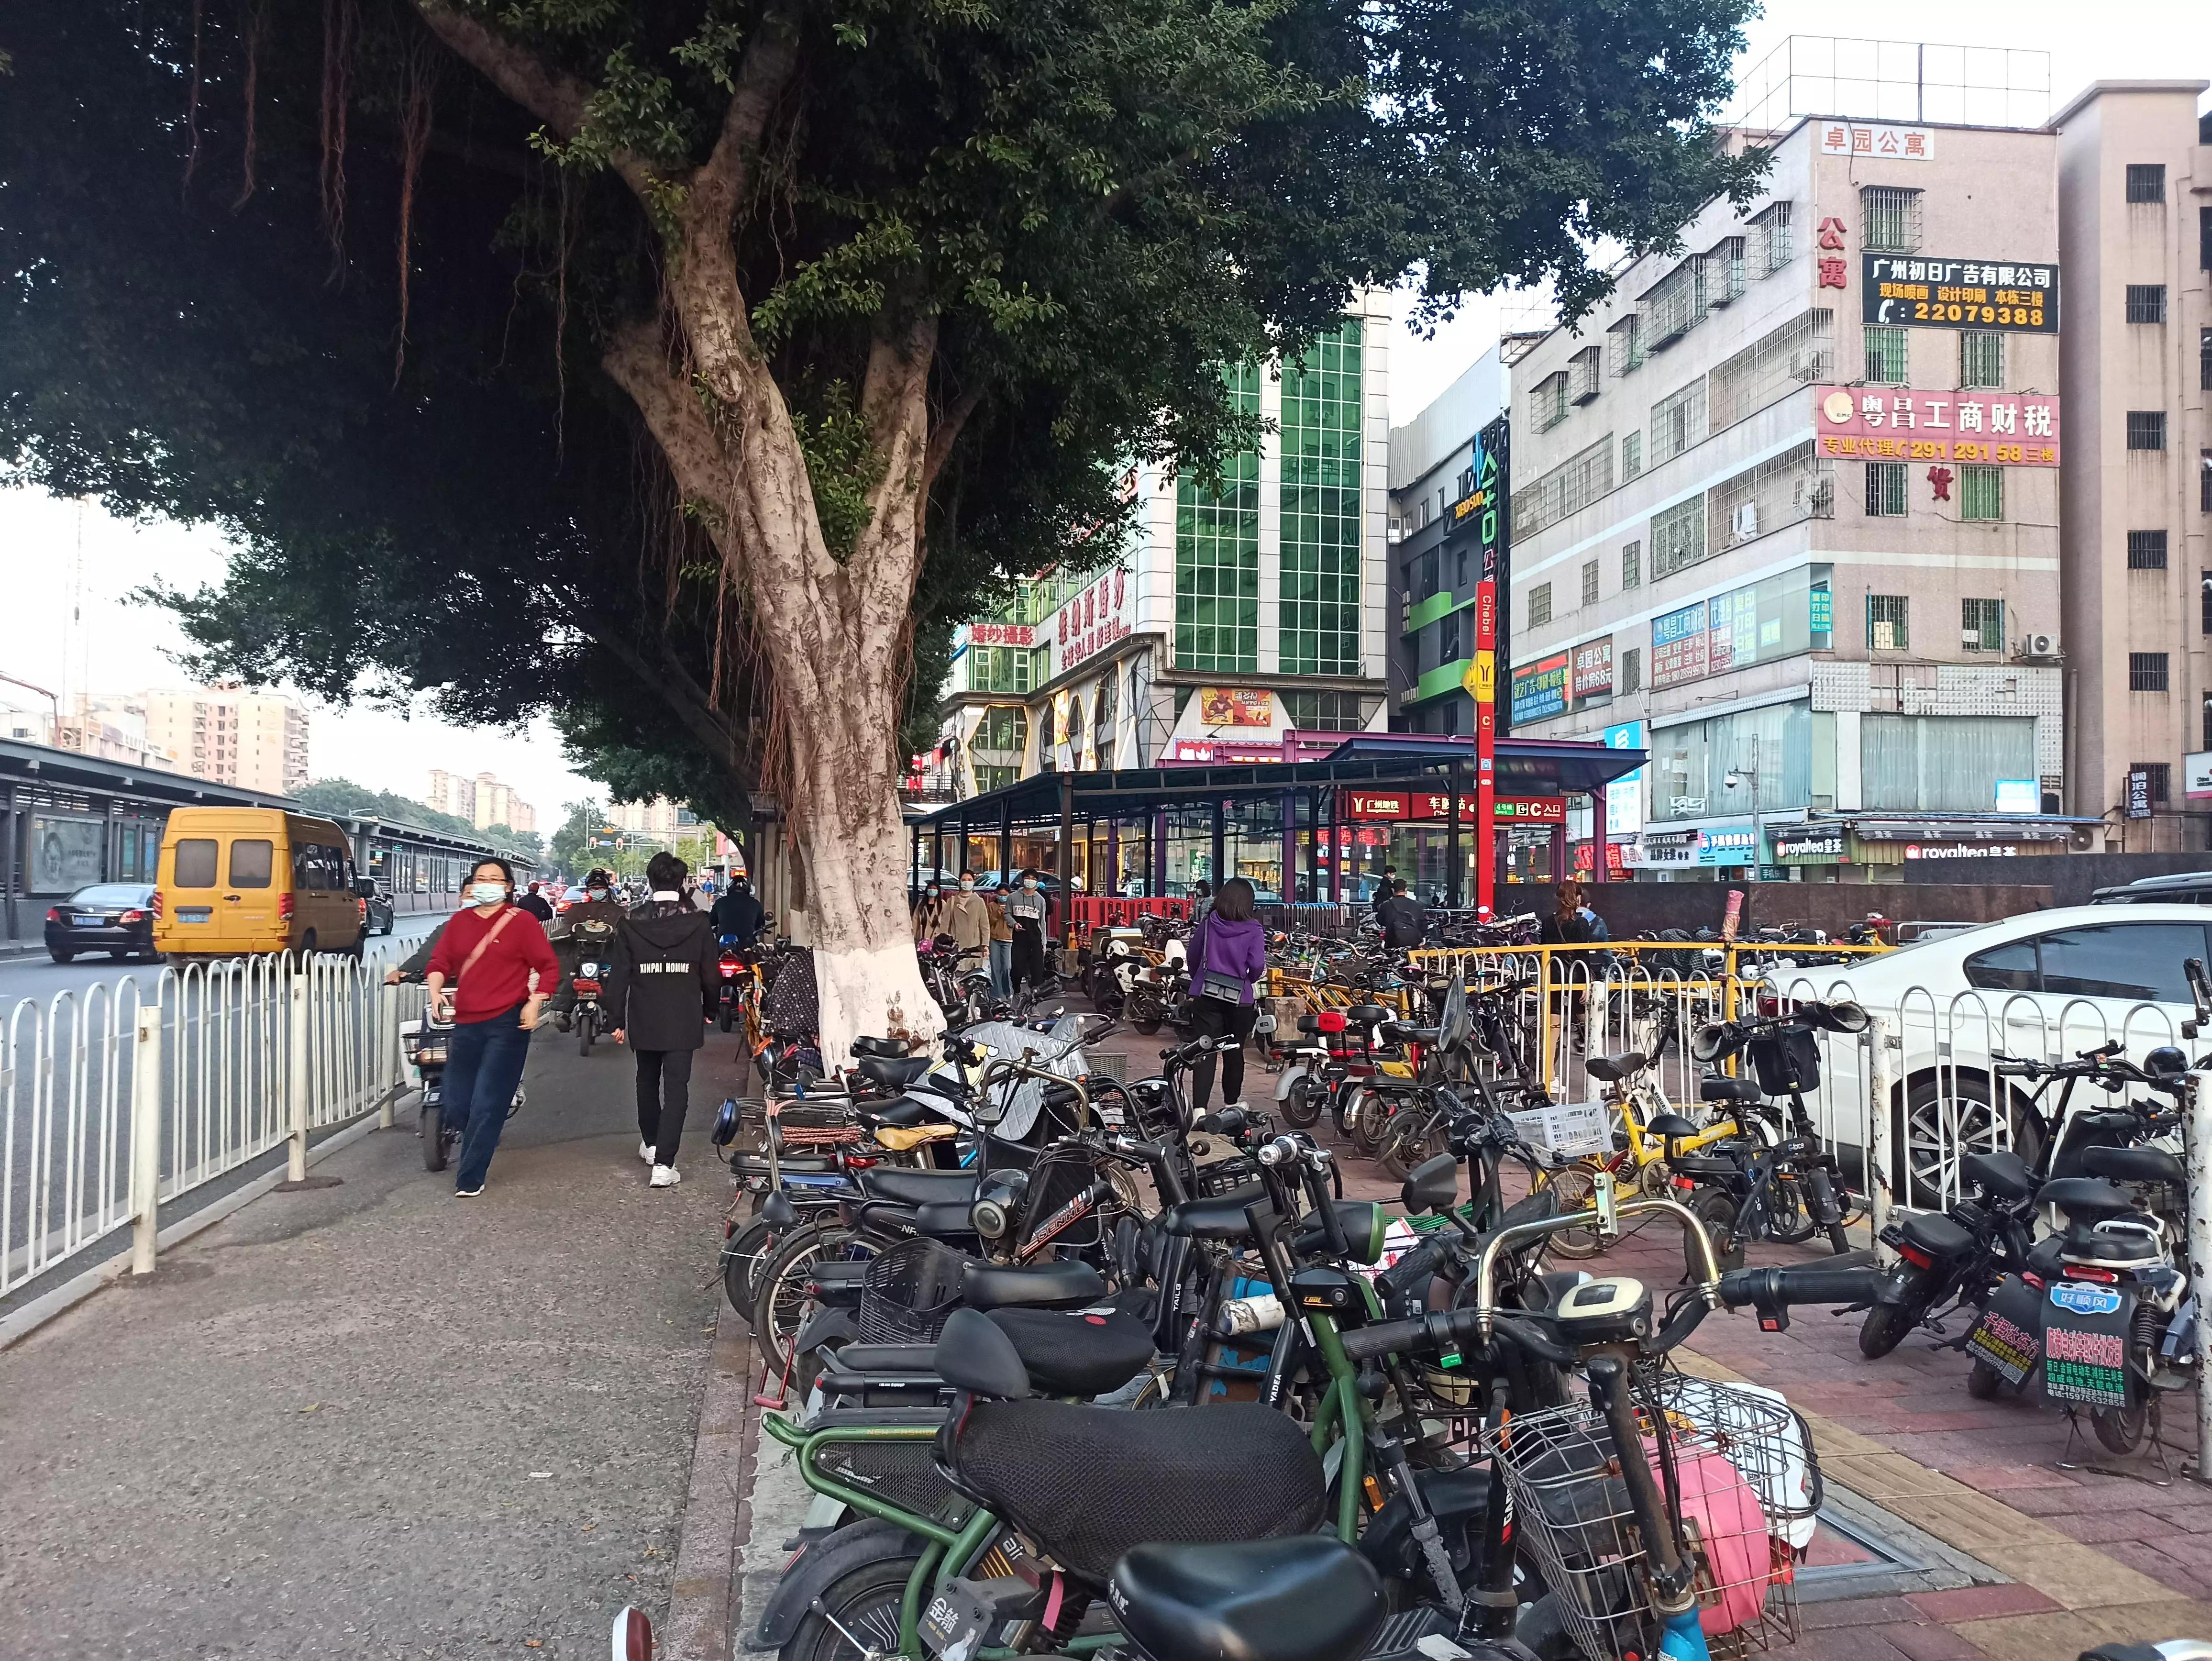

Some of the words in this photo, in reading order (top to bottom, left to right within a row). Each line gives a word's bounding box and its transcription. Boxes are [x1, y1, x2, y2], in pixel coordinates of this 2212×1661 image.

[1825, 126, 1925, 156] 卓园公寓
[1818, 217, 1847, 288] 公寓
[1872, 259, 2050, 288] 广州初日广告有限公司
[1879, 283, 1929, 300] 现场喷画
[1937, 286, 1986, 304] 设计印刷
[1994, 290, 2044, 308] 本栋三楼
[1859, 395, 2054, 437] 粤昌工商财税
[1823, 436, 1894, 456] 专业代理
[1910, 442, 1946, 459] 291
[1954, 443, 1989, 461] 291
[1996, 445, 2022, 462] 58
[2026, 448, 2054, 462] 三楼
[1482, 595, 1492, 636] Chebei
[971, 623, 1034, 645] 婚纱摄影
[1576, 644, 1611, 673] 卓园公寓
[1575, 667, 1612, 692] 特价房68元
[1482, 716, 1490, 726] C
[1366, 799, 1399, 809] 广州地铁
[1530, 803, 1542, 813] C
[1543, 804, 1560, 813] 入口
[1785, 837, 1824, 856] royaltea
[1824, 838, 1842, 853] 皇茶
[640, 963, 663, 974] XINPAI
[665, 962, 689, 973] HOMME
[1038, 1202, 1085, 1242] SENHE
[1172, 1283, 1182, 1311] TAILG
[2059, 1292, 2107, 1309] 好顺风
[1983, 1310, 2040, 1360] 千锂达车行
[1269, 1373, 1282, 1403] YADEA
[929, 1597, 959, 1635] 金箭
